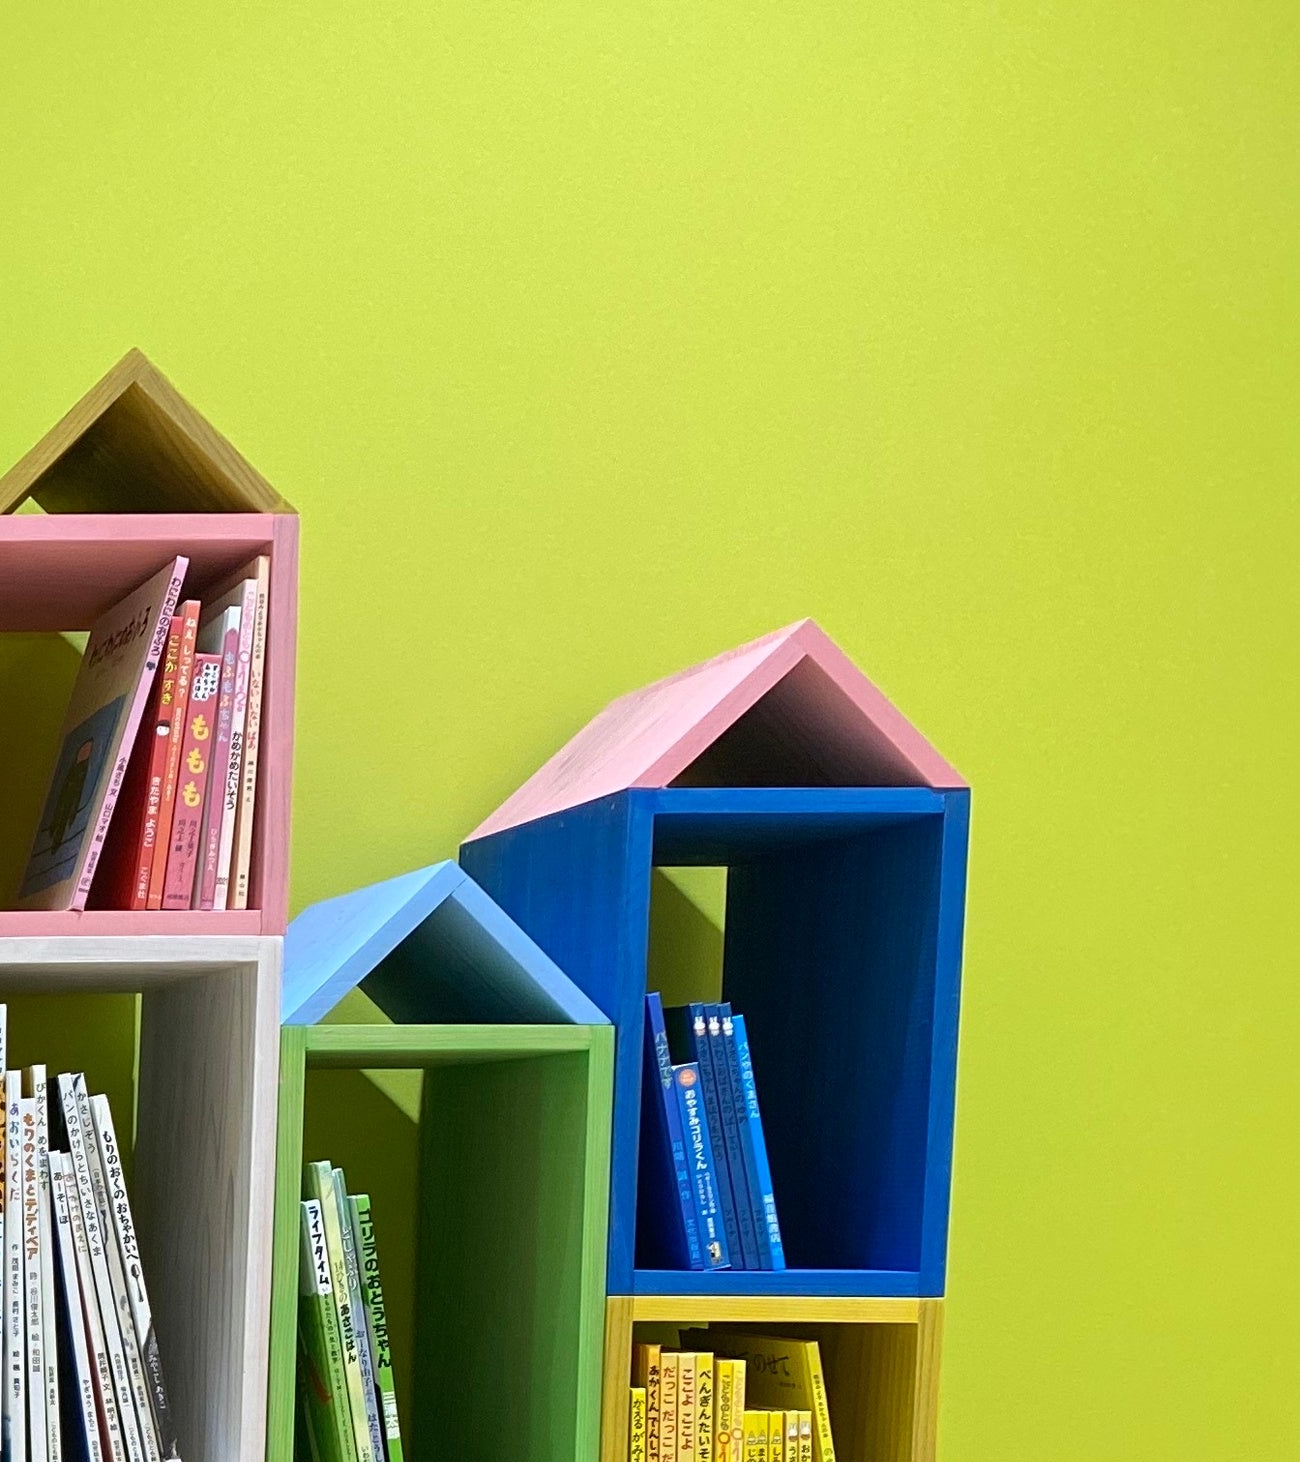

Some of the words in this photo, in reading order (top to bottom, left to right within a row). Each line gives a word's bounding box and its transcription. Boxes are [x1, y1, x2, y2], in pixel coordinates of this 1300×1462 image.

[150, 577, 182, 657] わにわにのおふろ
[185, 617, 197, 641] ねえ
[164, 634, 181, 673] ここが
[160, 679, 176, 705] すき
[225, 730, 244, 811] かめかめたいそう
[9, 1101, 21, 1201] あおいらくだ
[76, 1091, 97, 1155] かさじぞう
[22, 1112, 41, 1261] もりのくまとテディベア
[63, 1092, 102, 1256] パンのかけらとちいさなあくま
[102, 1130, 126, 1200] もりのおくの
[116, 1202, 139, 1261] おちゃかいへ
[307, 1205, 330, 1286] ライフタイム
[358, 1208, 393, 1369] ゴリラのおとうちゃん
[647, 1365, 660, 1415] あかくん
[662, 1367, 676, 1403] だっこ
[681, 1368, 694, 1406] ここよ
[662, 1410, 676, 1448] だっこ
[681, 1412, 694, 1450] ここよ
